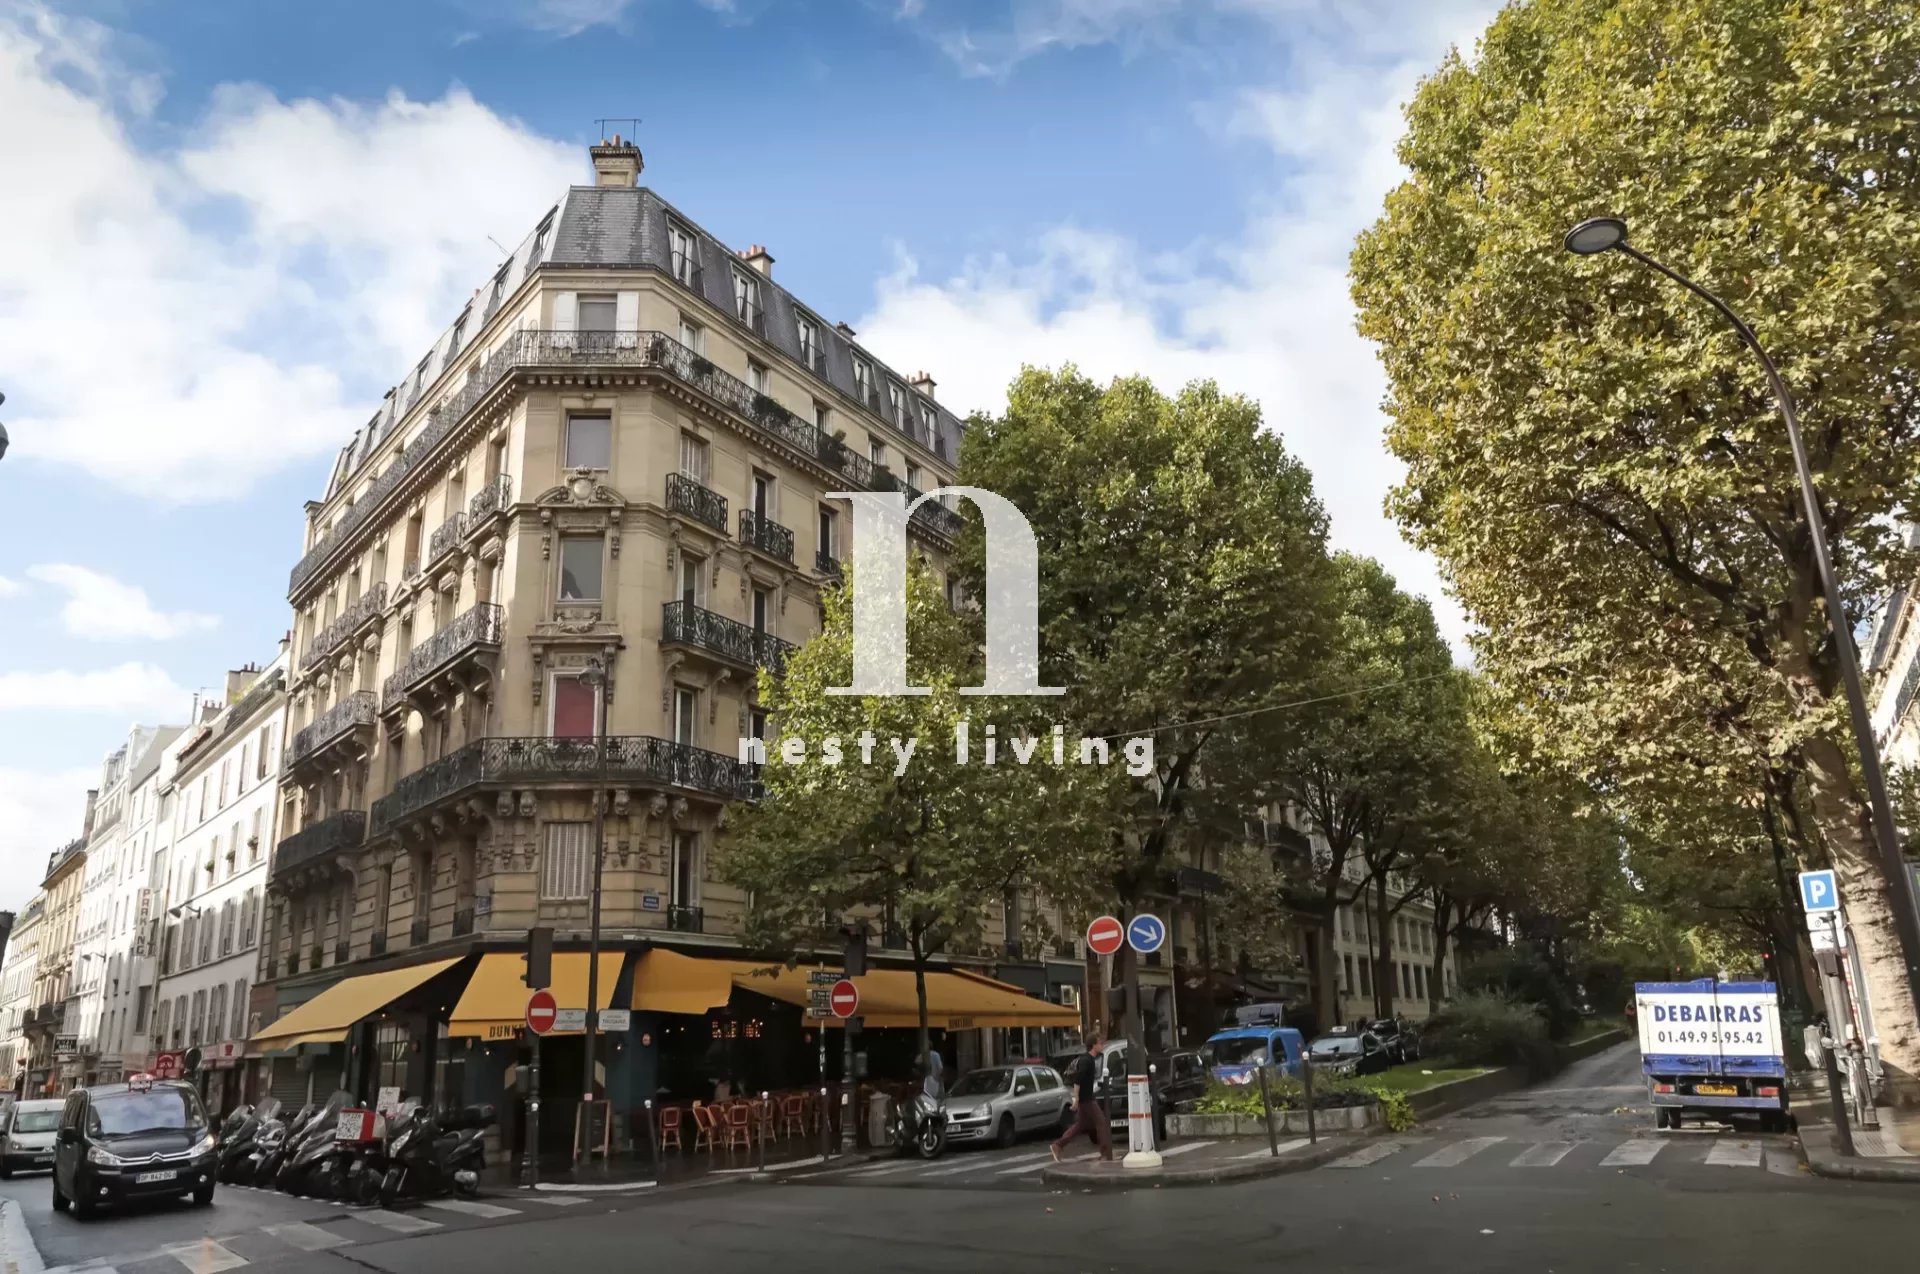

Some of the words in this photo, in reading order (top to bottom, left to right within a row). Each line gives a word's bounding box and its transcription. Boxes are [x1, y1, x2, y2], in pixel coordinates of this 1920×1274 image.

[1810, 880, 1826, 904] P
[136, 888, 151, 955] PARKING
[1654, 1005, 1763, 1023] DEBARRAS
